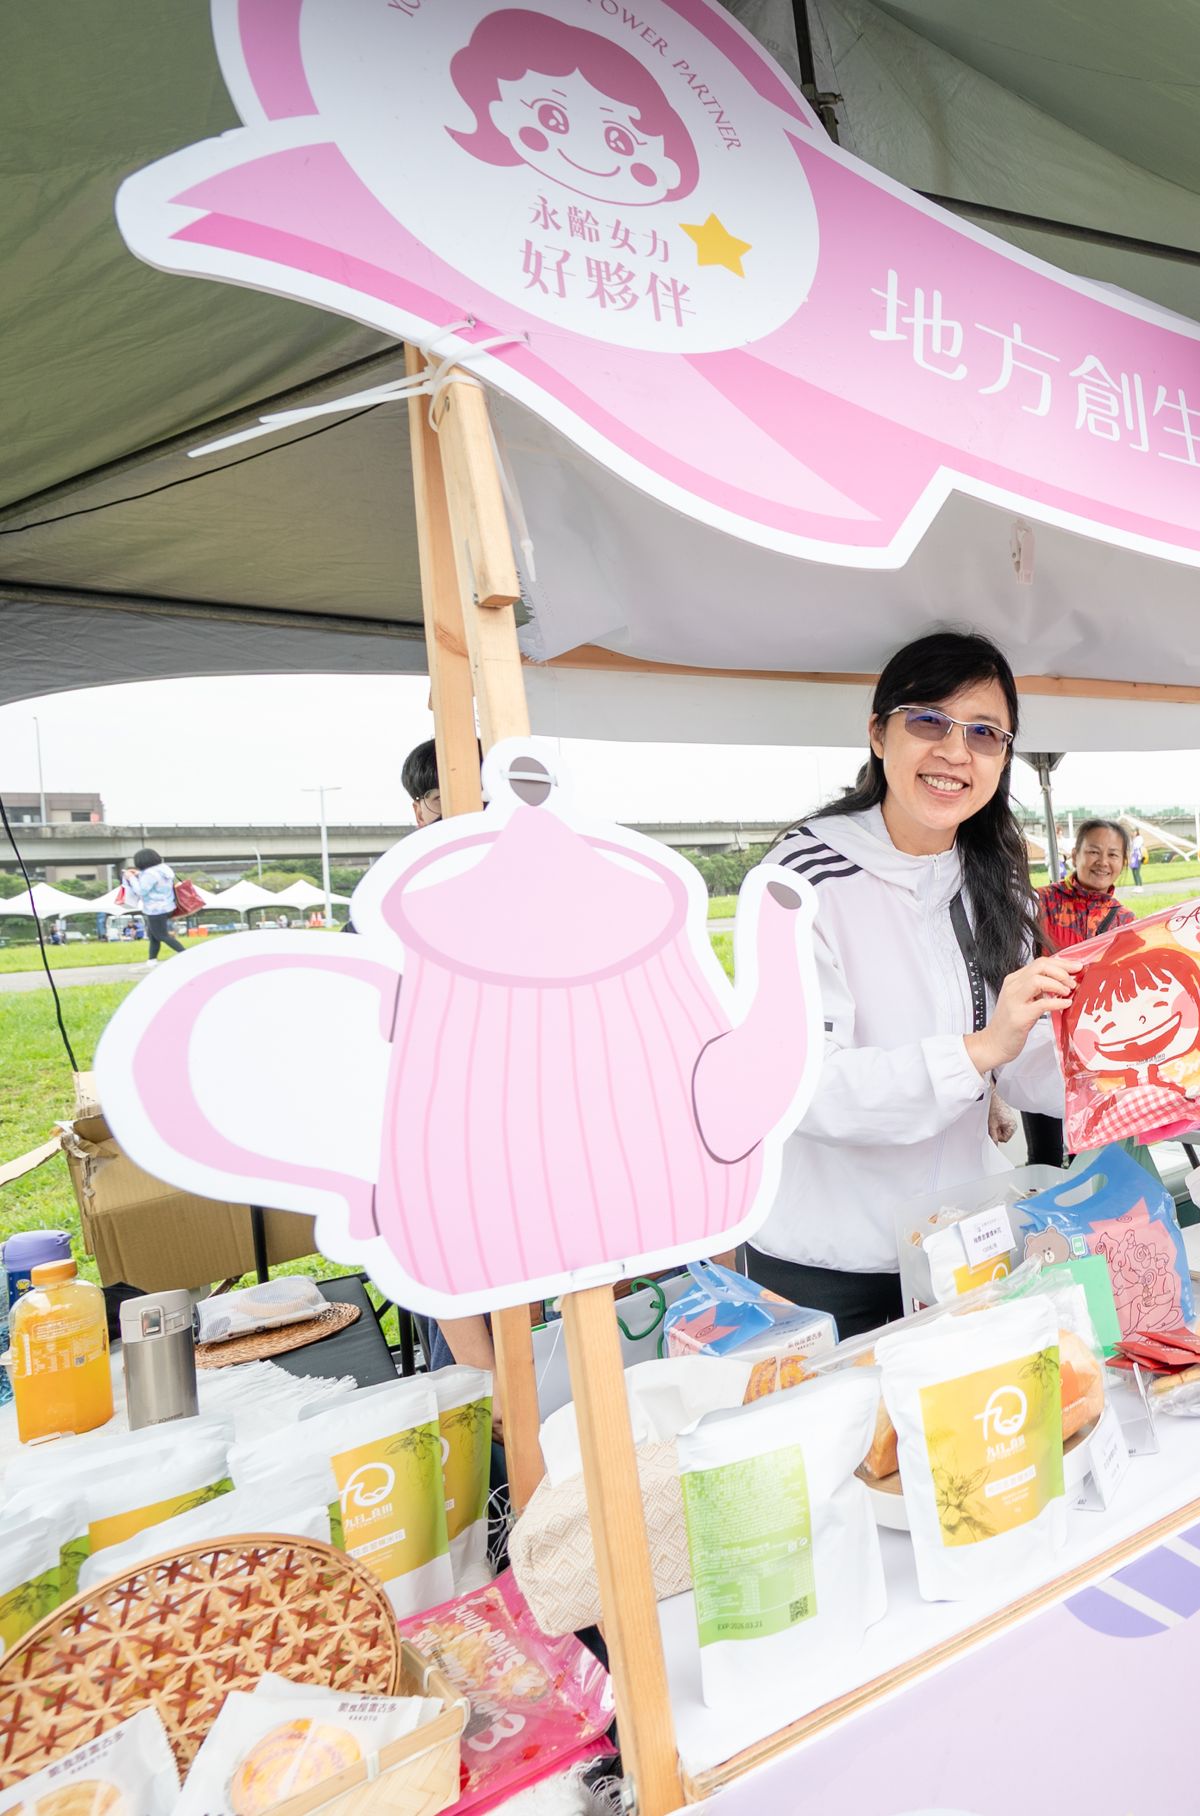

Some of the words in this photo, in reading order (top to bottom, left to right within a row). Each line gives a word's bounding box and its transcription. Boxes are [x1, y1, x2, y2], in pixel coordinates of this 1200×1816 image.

[586, 0, 669, 57] OWER
[672, 59, 742, 150] PARTNER
[529, 196, 671, 263] 永齡女力
[519, 239, 696, 327] 好夥伴
